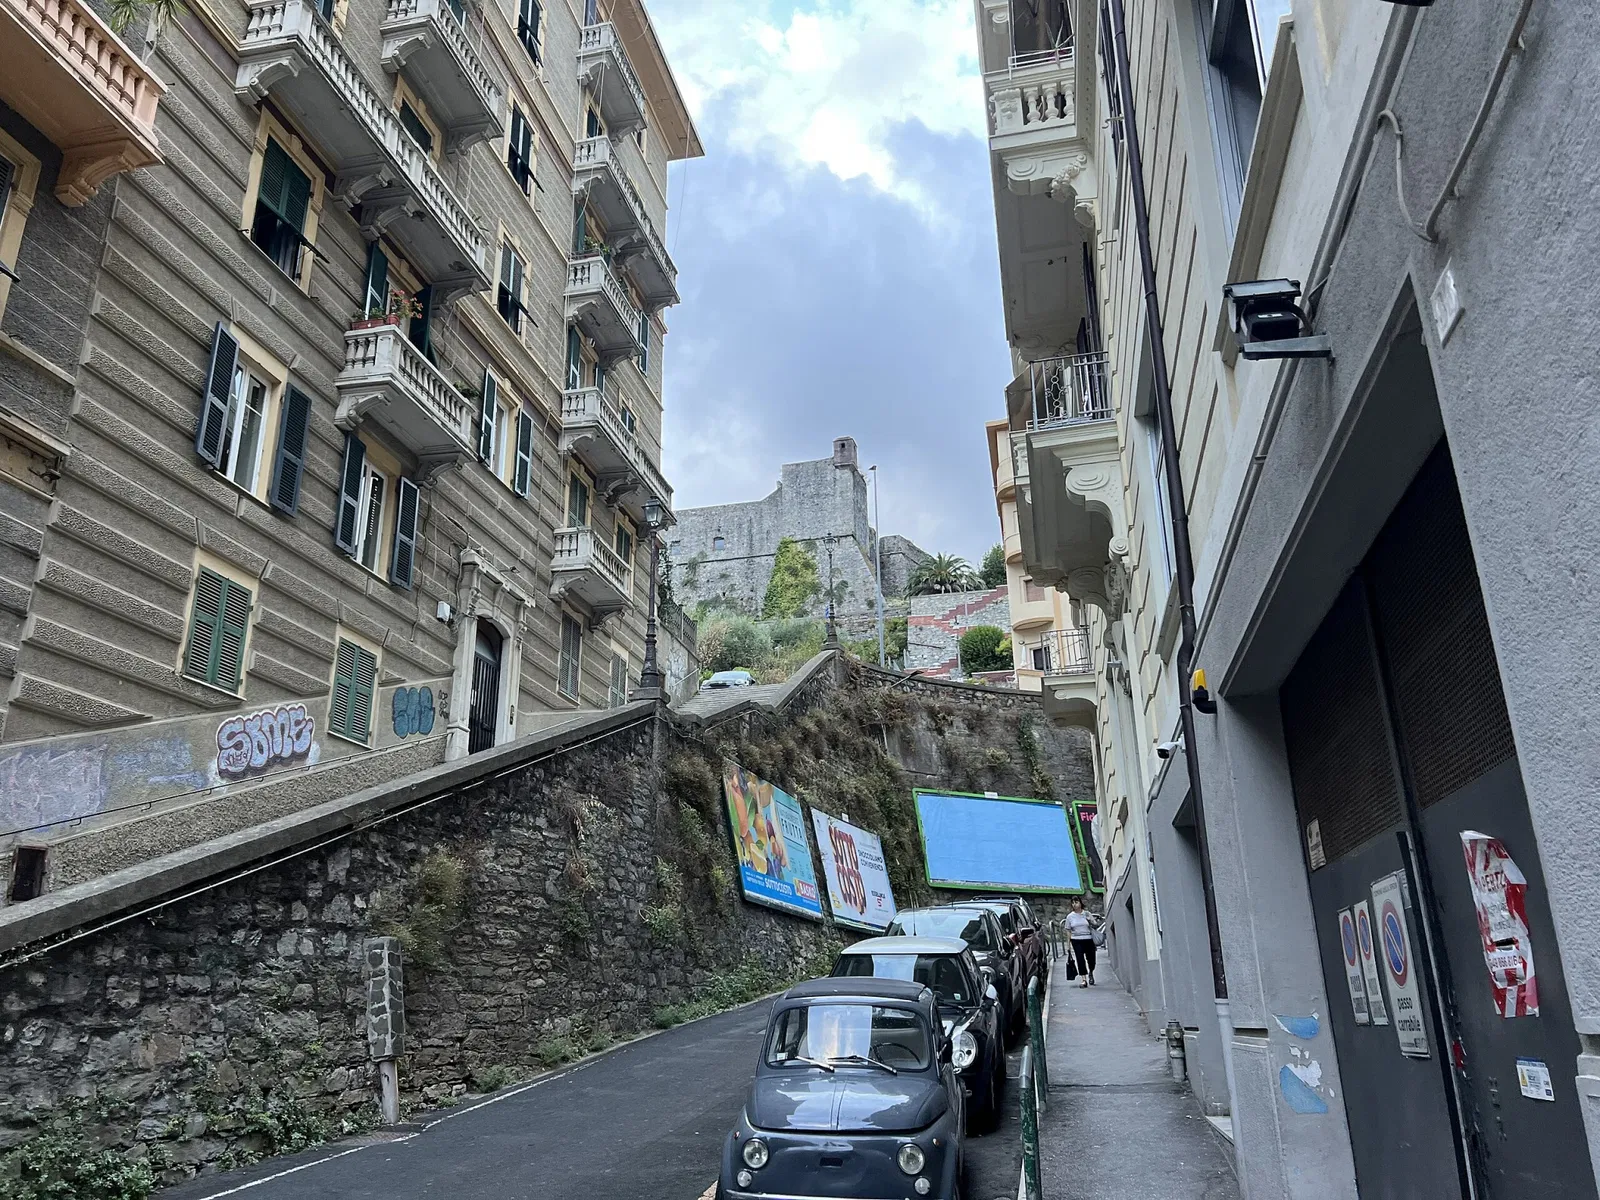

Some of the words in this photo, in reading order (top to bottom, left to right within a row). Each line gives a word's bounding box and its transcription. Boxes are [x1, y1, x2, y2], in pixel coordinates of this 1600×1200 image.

[780, 818, 803, 839] FRUTTA
[828, 824, 859, 871] SOTTO
[764, 877, 793, 896] SOTTOCOSTO
[836, 863, 867, 915] COSTO
[1397, 996, 1413, 1013] passo
[1398, 1014, 1421, 1032] carrabile
